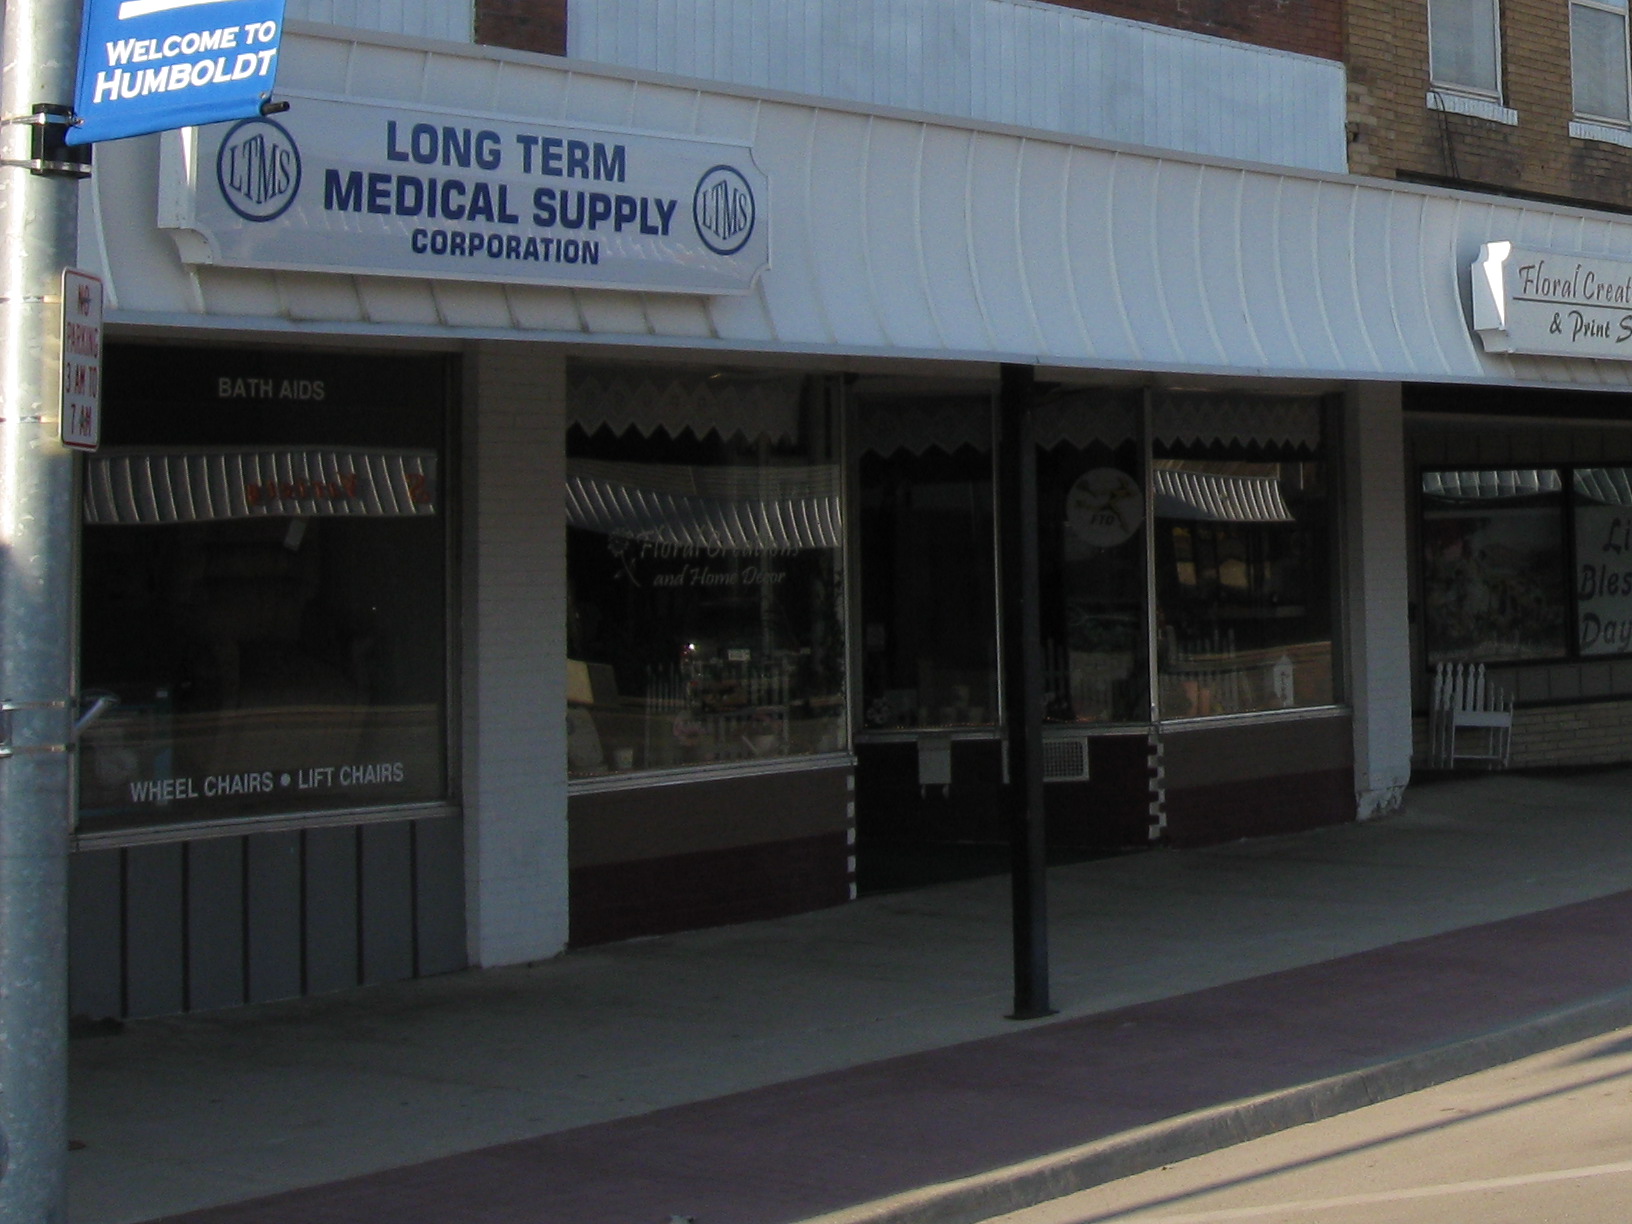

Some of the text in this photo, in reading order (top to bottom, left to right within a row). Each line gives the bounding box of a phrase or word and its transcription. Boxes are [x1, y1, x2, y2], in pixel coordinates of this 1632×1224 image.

[106, 20, 276, 66] WELCOME TO
[93, 48, 277, 103] HUMBOLDT
[228, 134, 291, 204] LTMS
[387, 120, 626, 182] LONG TERM
[324, 168, 678, 236] MEDICAL SUPPLY
[701, 180, 748, 240] LTMS
[411, 228, 599, 265] CORPORATION
[1519, 260, 1582, 298] Floral
[77, 284, 91, 317] NO
[1549, 312, 1562, 335] &
[1567, 310, 1610, 342] Print
[66, 362, 97, 399] 3 AM TO
[218, 378, 325, 400] BATH AIDS
[71, 403, 92, 437] 7 AM
[636, 526, 705, 559] Floral
[653, 564, 689, 587] and
[689, 568, 735, 587] Home
[1578, 611, 1632, 653] Day
[130, 763, 404, 802] WHEEL CHAIRS LIFT CHAIRS
